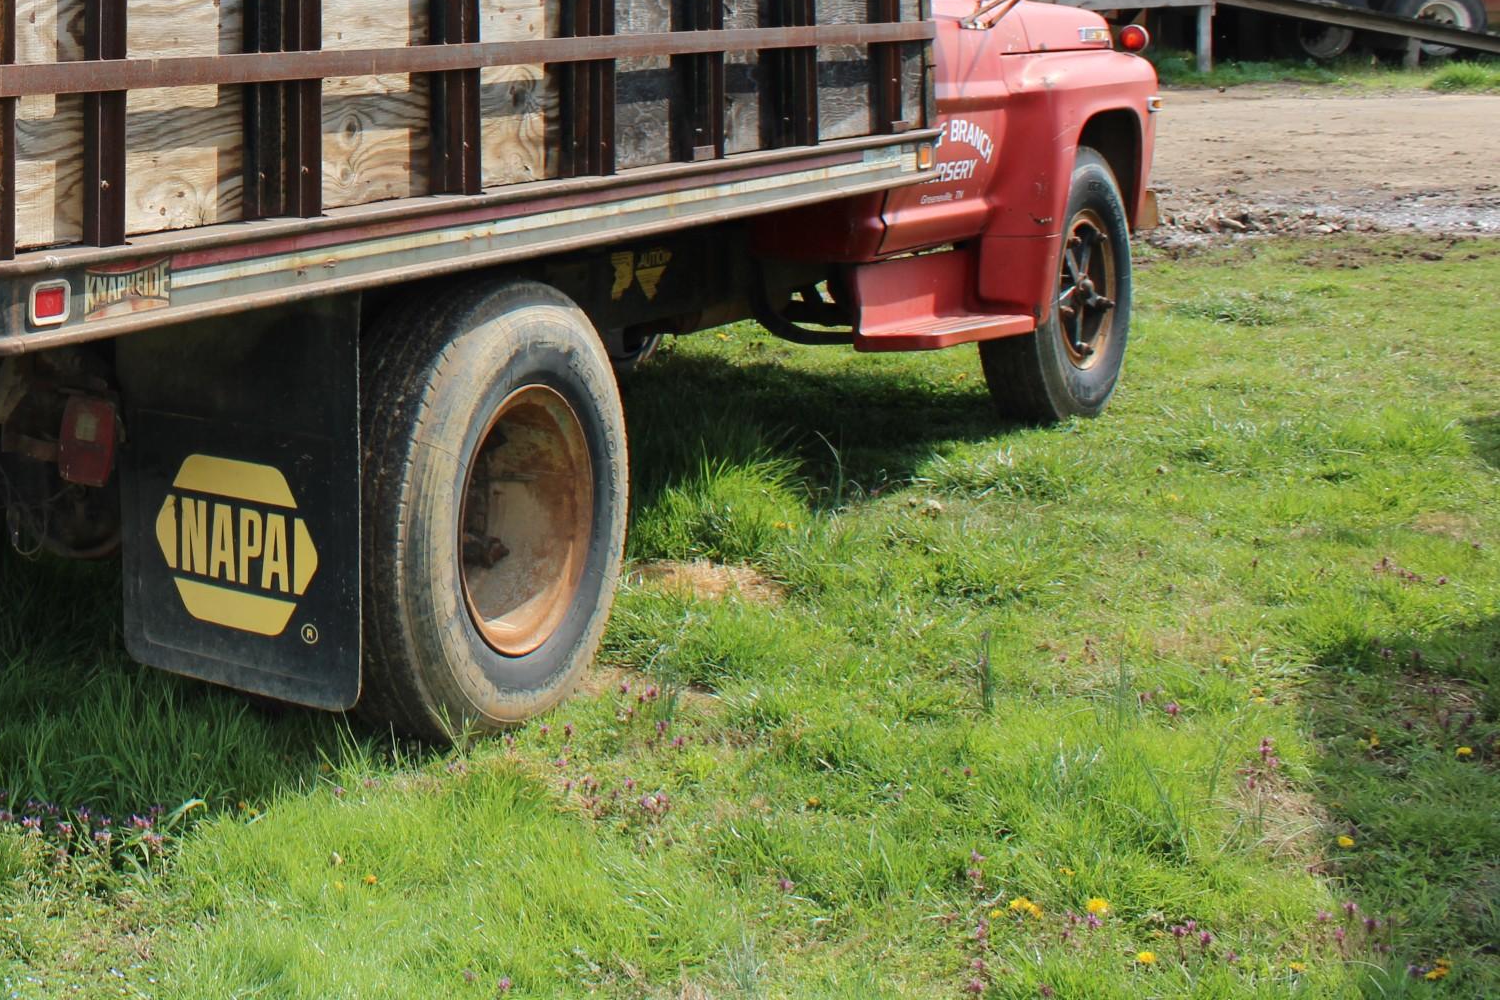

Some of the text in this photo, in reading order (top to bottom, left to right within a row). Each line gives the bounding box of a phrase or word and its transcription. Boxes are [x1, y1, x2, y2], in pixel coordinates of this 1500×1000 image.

[949, 119, 994, 164] BRANCH
[922, 159, 978, 184] RSERY
[84, 260, 170, 314] KNAPHEIDE
[181, 496, 290, 594] NAPA
